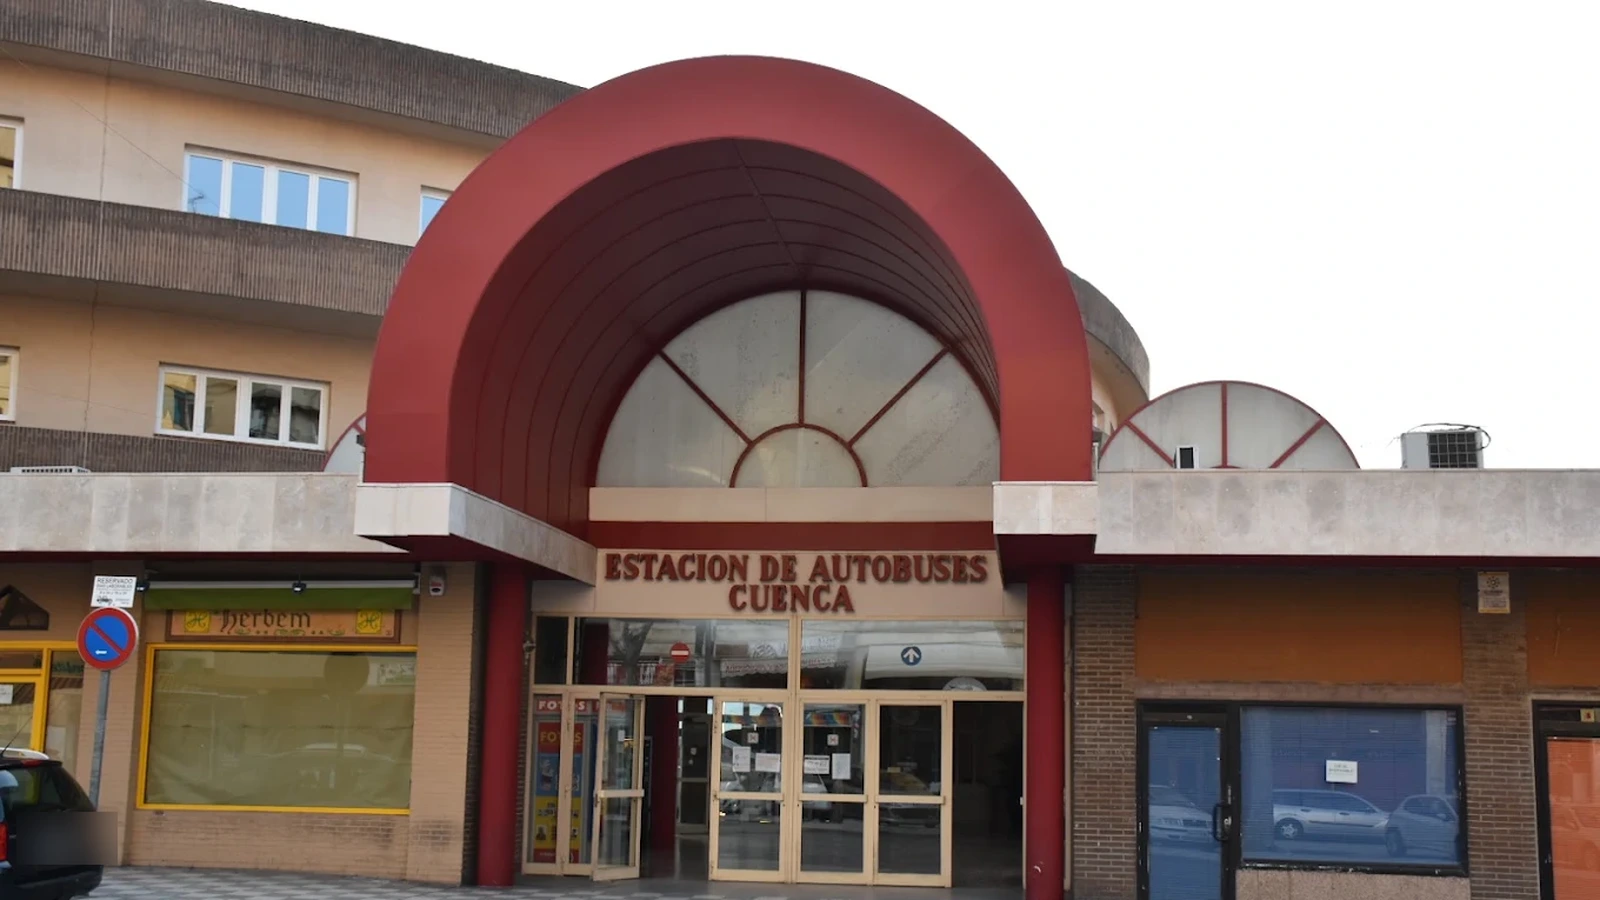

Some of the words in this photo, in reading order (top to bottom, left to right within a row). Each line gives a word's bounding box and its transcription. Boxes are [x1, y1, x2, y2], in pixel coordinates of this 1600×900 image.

[604, 553, 749, 582] ESTACION
[760, 554, 797, 583] DE
[809, 554, 989, 584] AUTOBUSES
[728, 584, 855, 613] CUENCA
[538, 700, 586, 711] FOS
[541, 731, 583, 743] FOS
